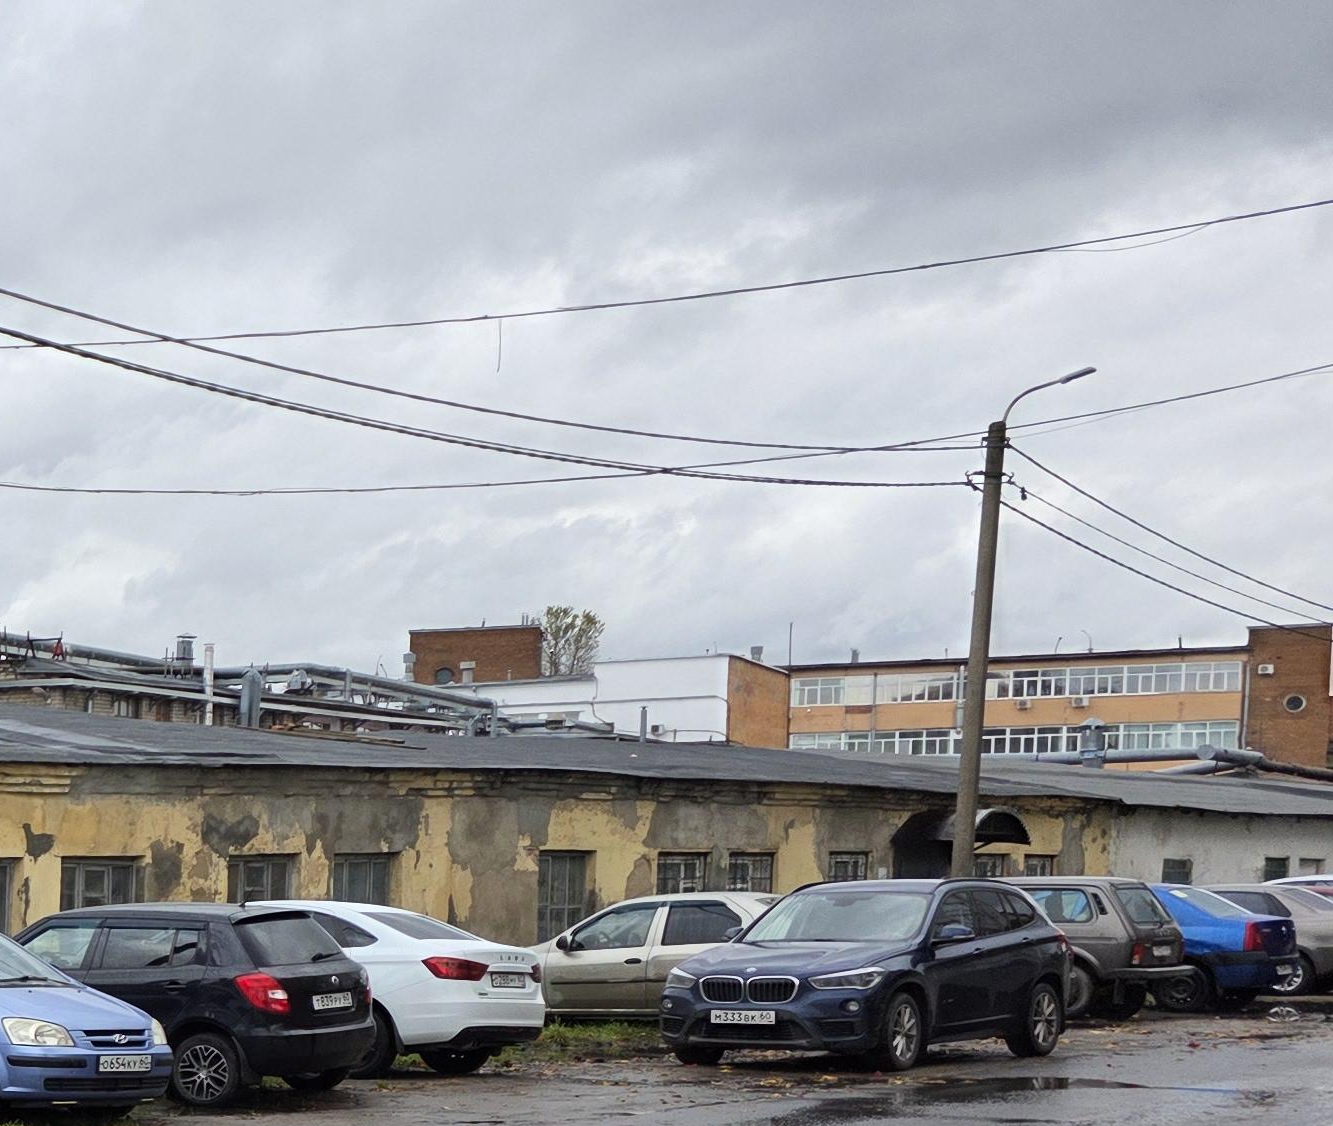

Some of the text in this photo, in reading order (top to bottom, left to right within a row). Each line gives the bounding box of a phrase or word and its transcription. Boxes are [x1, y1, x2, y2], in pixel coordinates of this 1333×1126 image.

[714, 1011, 757, 1023] М333ВК
[102, 1056, 149, 1070] О654КУ 60
